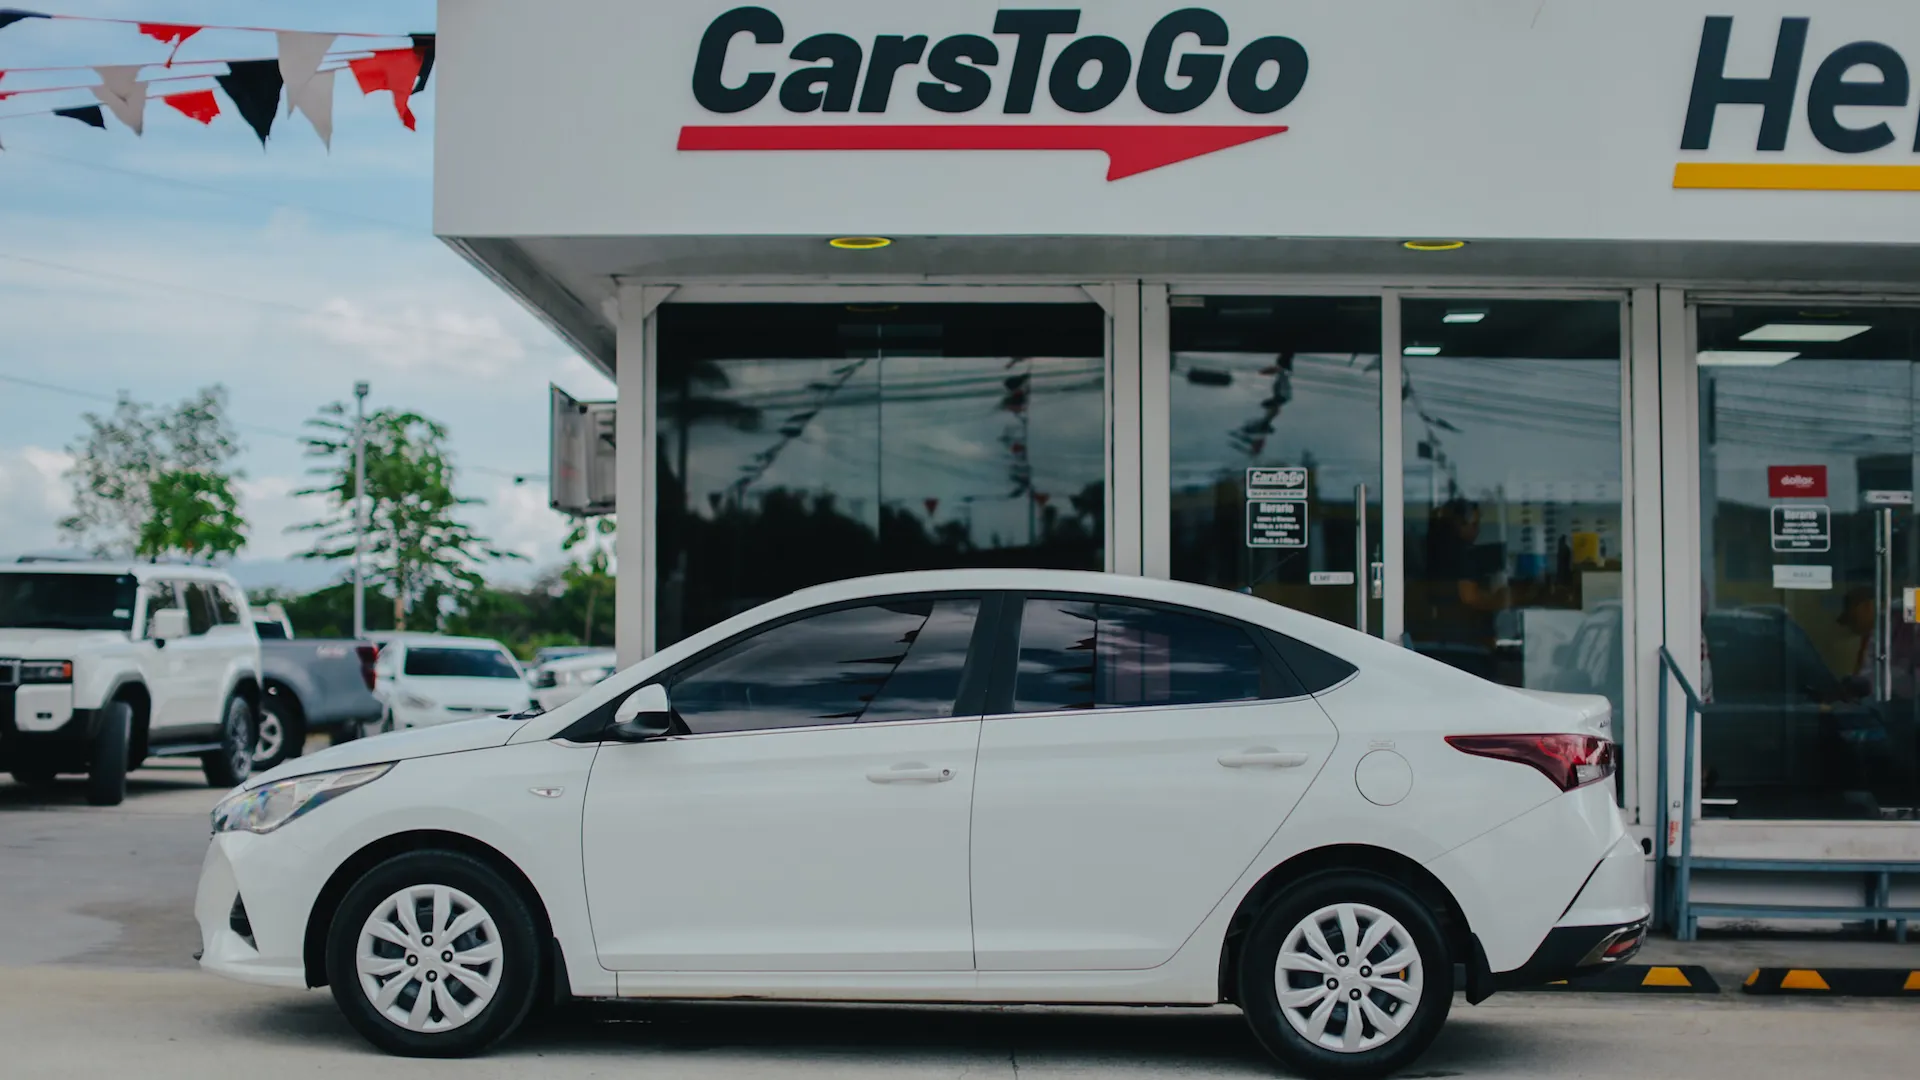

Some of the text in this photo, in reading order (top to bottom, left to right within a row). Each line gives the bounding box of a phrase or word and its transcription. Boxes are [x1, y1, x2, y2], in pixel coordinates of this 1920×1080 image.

[692, 6, 1309, 115] CarsToGo
[1680, 16, 1920, 154] He
[1252, 471, 1304, 482] CarsToGo
[1260, 502, 1294, 513] Horario
